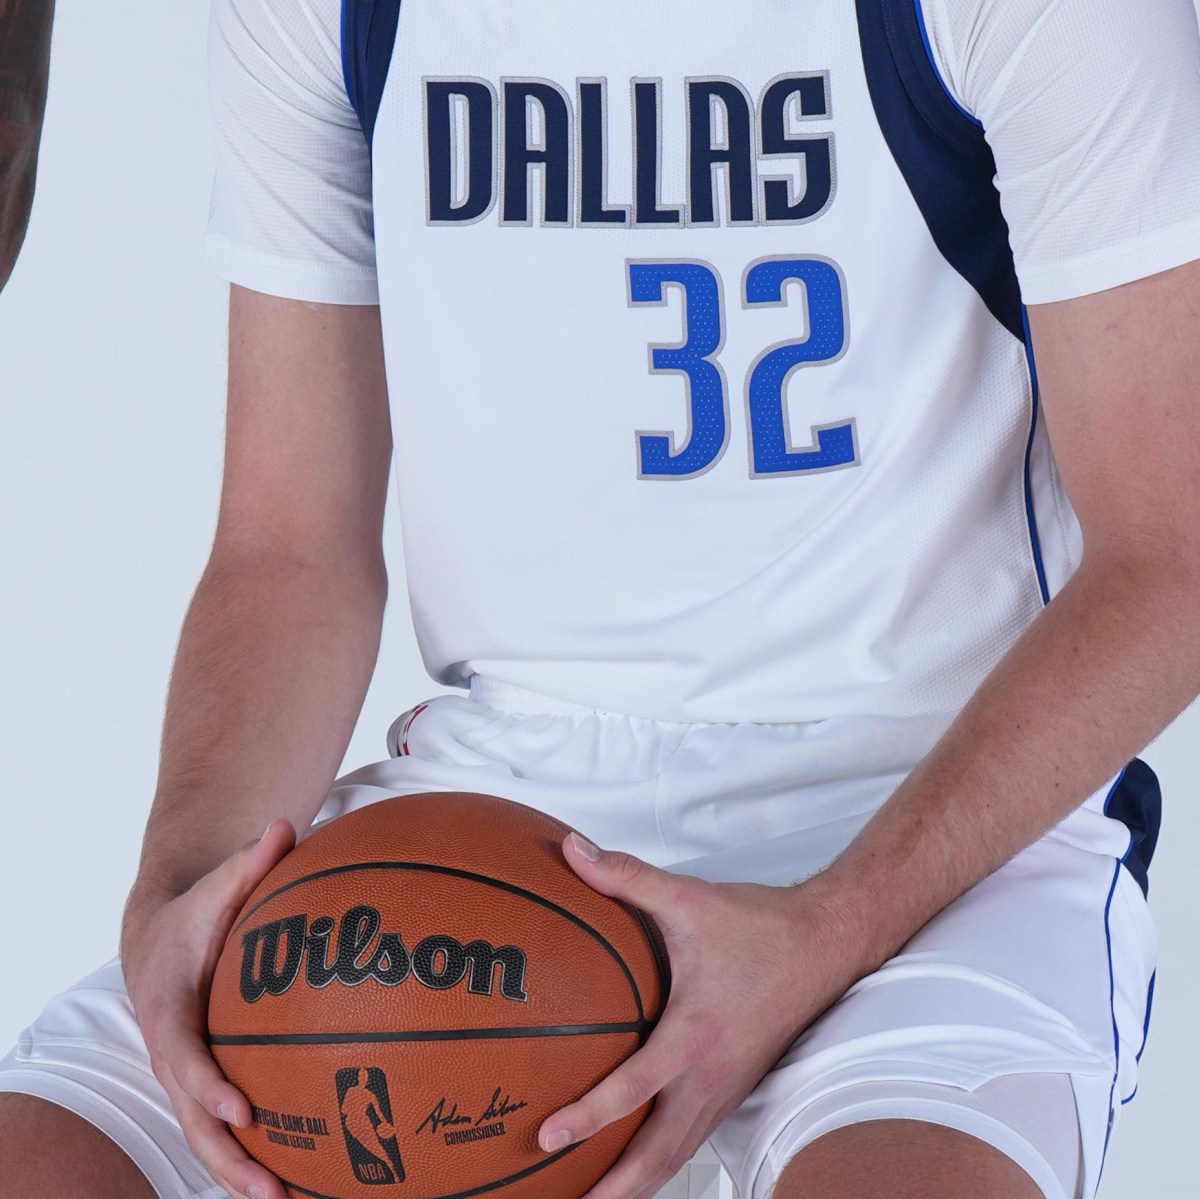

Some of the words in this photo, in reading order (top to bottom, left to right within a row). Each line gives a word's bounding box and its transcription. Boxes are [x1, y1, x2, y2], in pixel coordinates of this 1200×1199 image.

[421, 69, 838, 229] DALLAS
[625, 253, 862, 480] 32
[239, 904, 529, 1004] Wilson
[281, 1112, 306, 1134] GAME
[305, 1116, 331, 1136] BALL
[443, 1121, 506, 1146] COMMISSIONER
[358, 1162, 386, 1181] NBA
